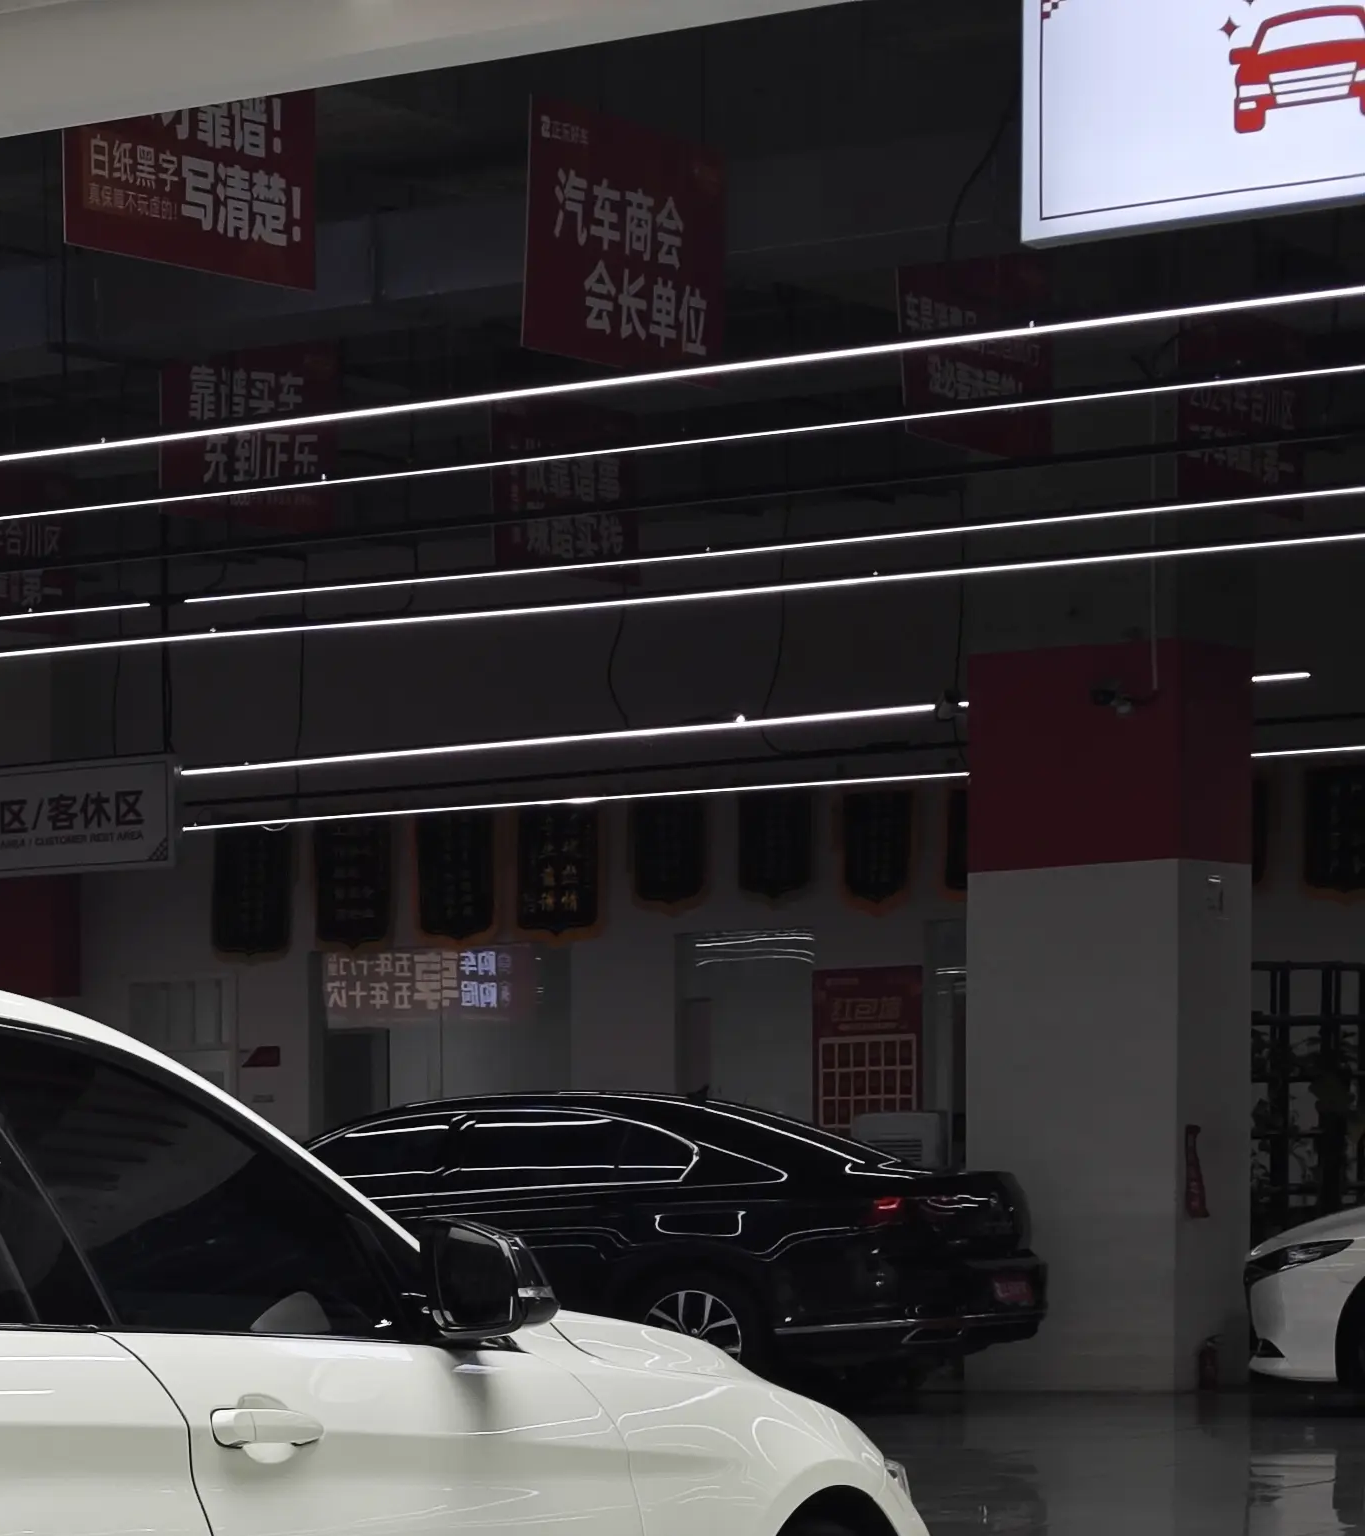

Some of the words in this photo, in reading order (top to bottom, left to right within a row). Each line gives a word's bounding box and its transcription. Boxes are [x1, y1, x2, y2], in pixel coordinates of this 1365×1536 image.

[89, 134, 179, 193] 白纸黑字
[181, 154, 303, 248] 写清楚!
[553, 167, 685, 271] 汽车商会
[583, 257, 708, 357] 会长单位
[187, 363, 305, 422] 靠谱买车
[202, 430, 319, 485] 先到正乐
